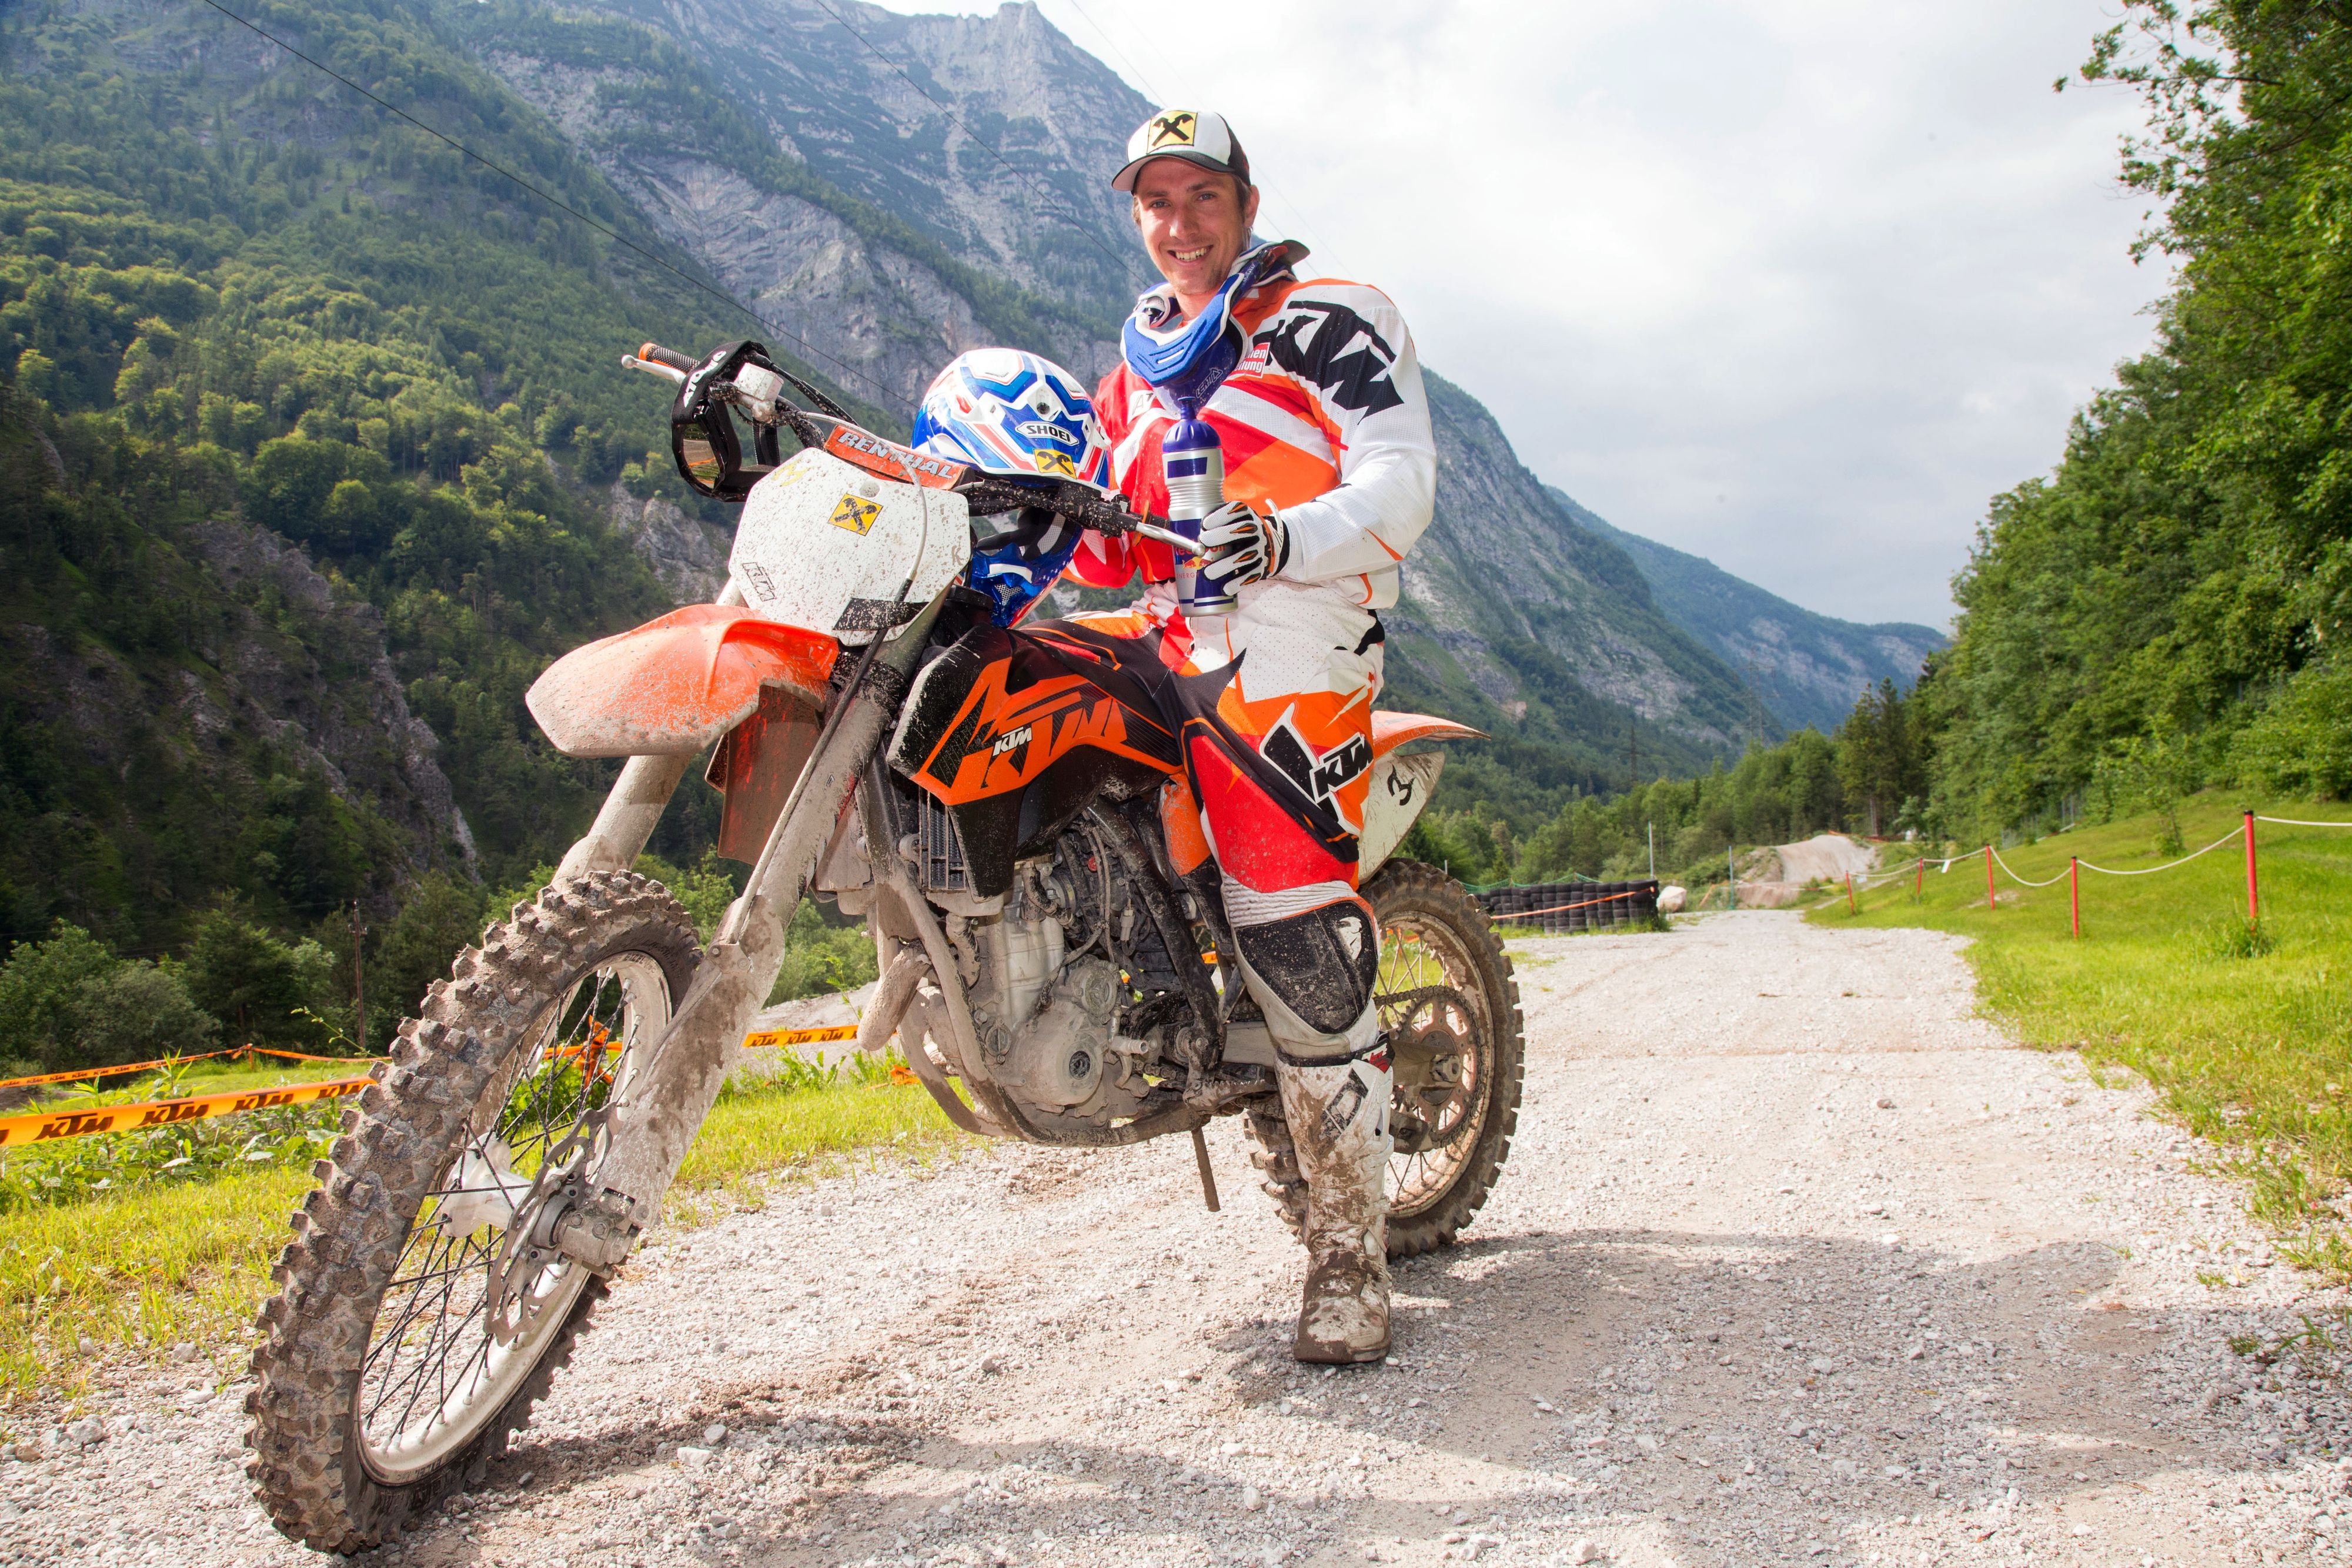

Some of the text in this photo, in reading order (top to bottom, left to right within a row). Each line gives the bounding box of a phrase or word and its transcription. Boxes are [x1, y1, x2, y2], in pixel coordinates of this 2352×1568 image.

[1252, 300, 1405, 425] KTM
[1026, 425, 1071, 442] SHOEI
[993, 727, 1033, 757] KTM
[1314, 735, 1374, 798] KTM
[32, 1113, 114, 1141] KTM
[136, 1101, 209, 1126] KTM
[229, 1091, 294, 1113] KTM
